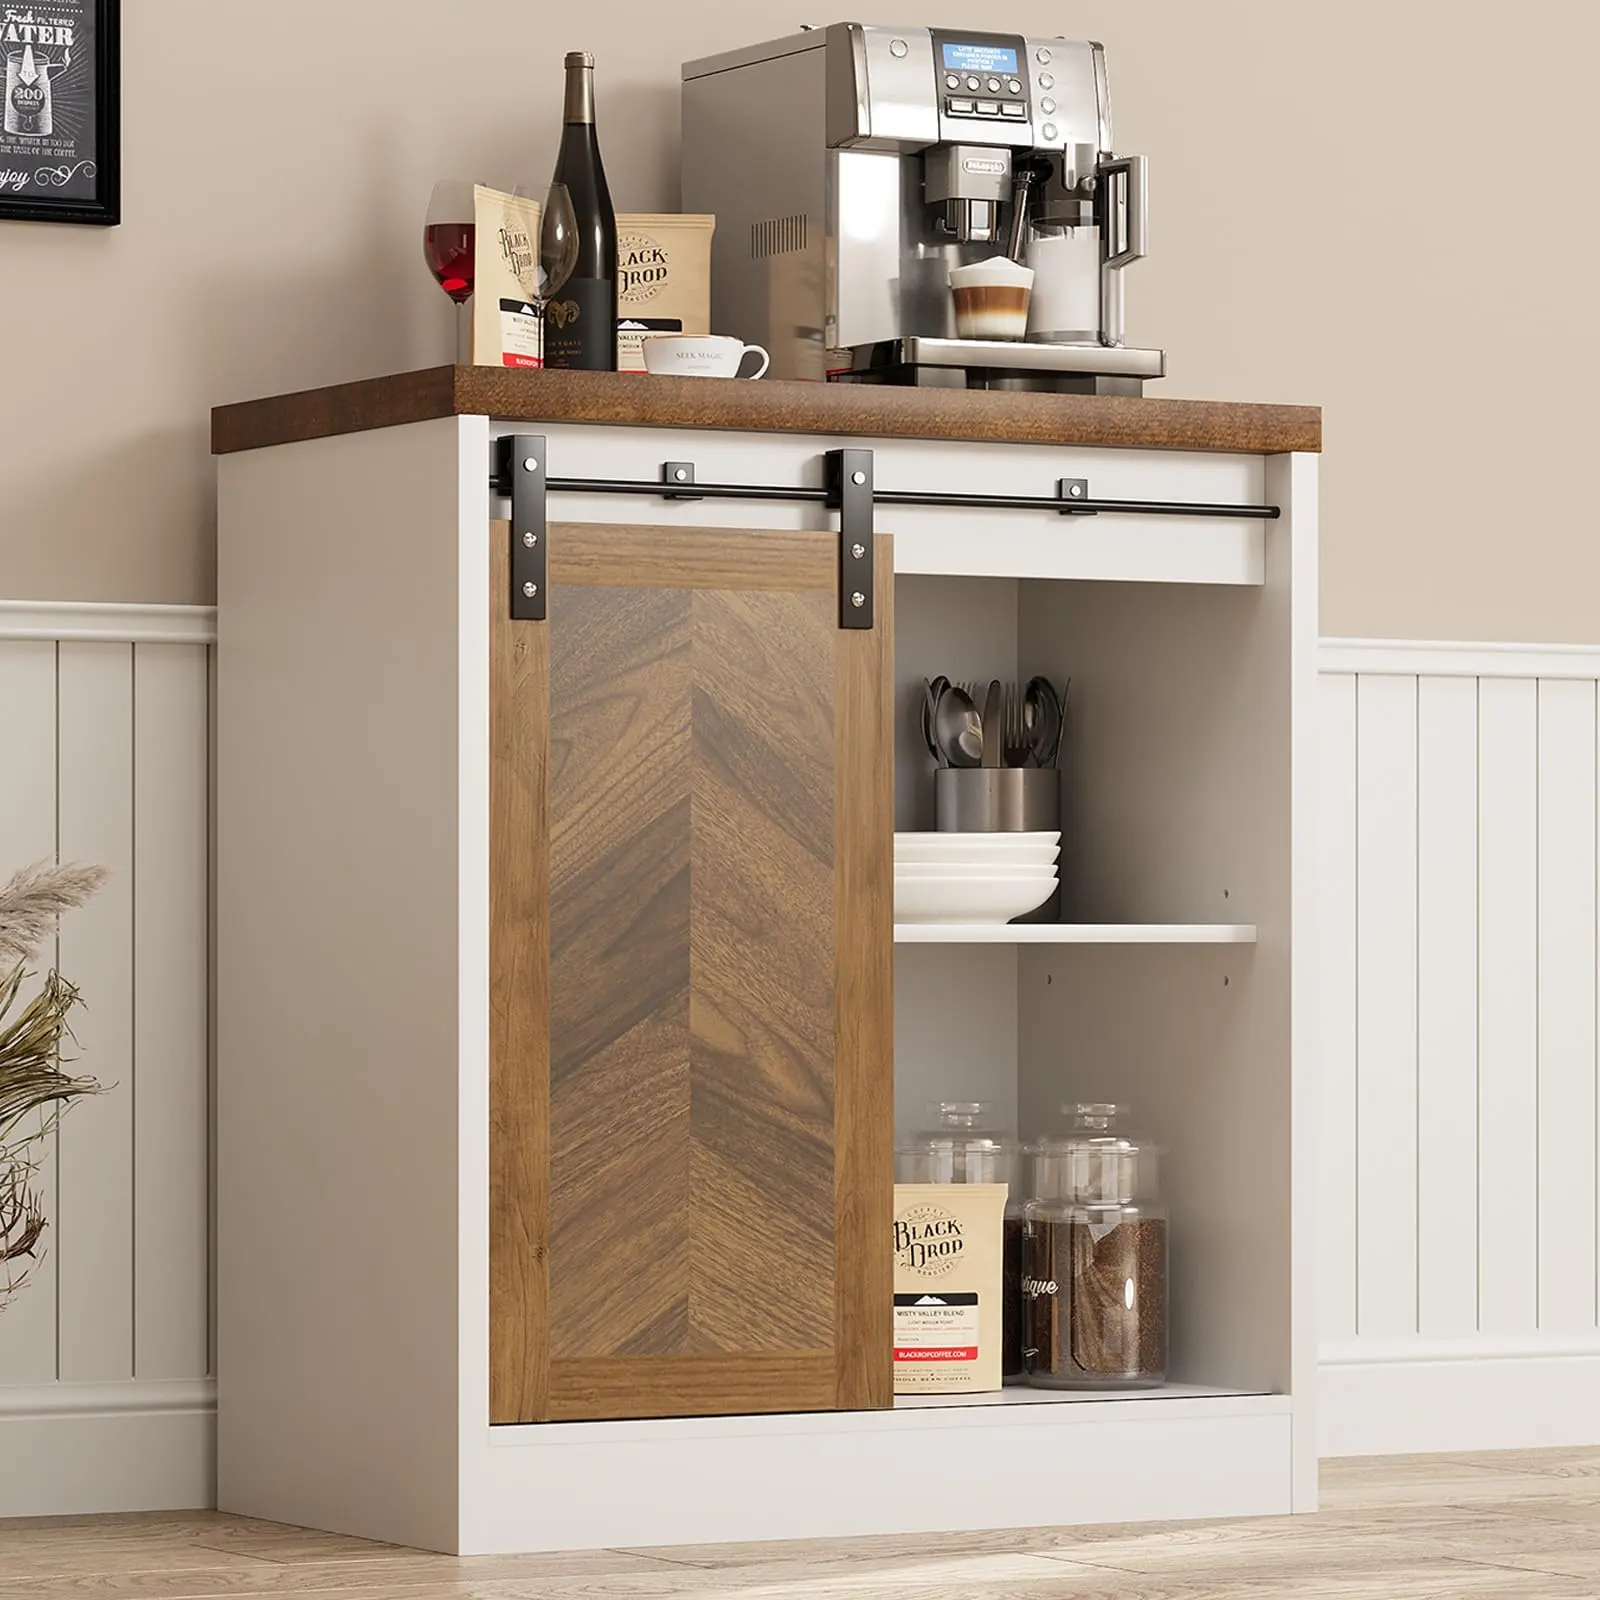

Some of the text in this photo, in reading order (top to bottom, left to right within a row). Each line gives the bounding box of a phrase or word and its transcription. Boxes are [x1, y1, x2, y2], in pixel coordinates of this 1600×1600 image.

[3, 10, 34, 23] Fresh
[14, 87, 43, 100] 200
[0, 168, 31, 191] njoy
[499, 229, 529, 257] BLACK
[510, 251, 532, 275] DROP
[893, 1219, 961, 1252] BLACK
[910, 1239, 963, 1268] DROP
